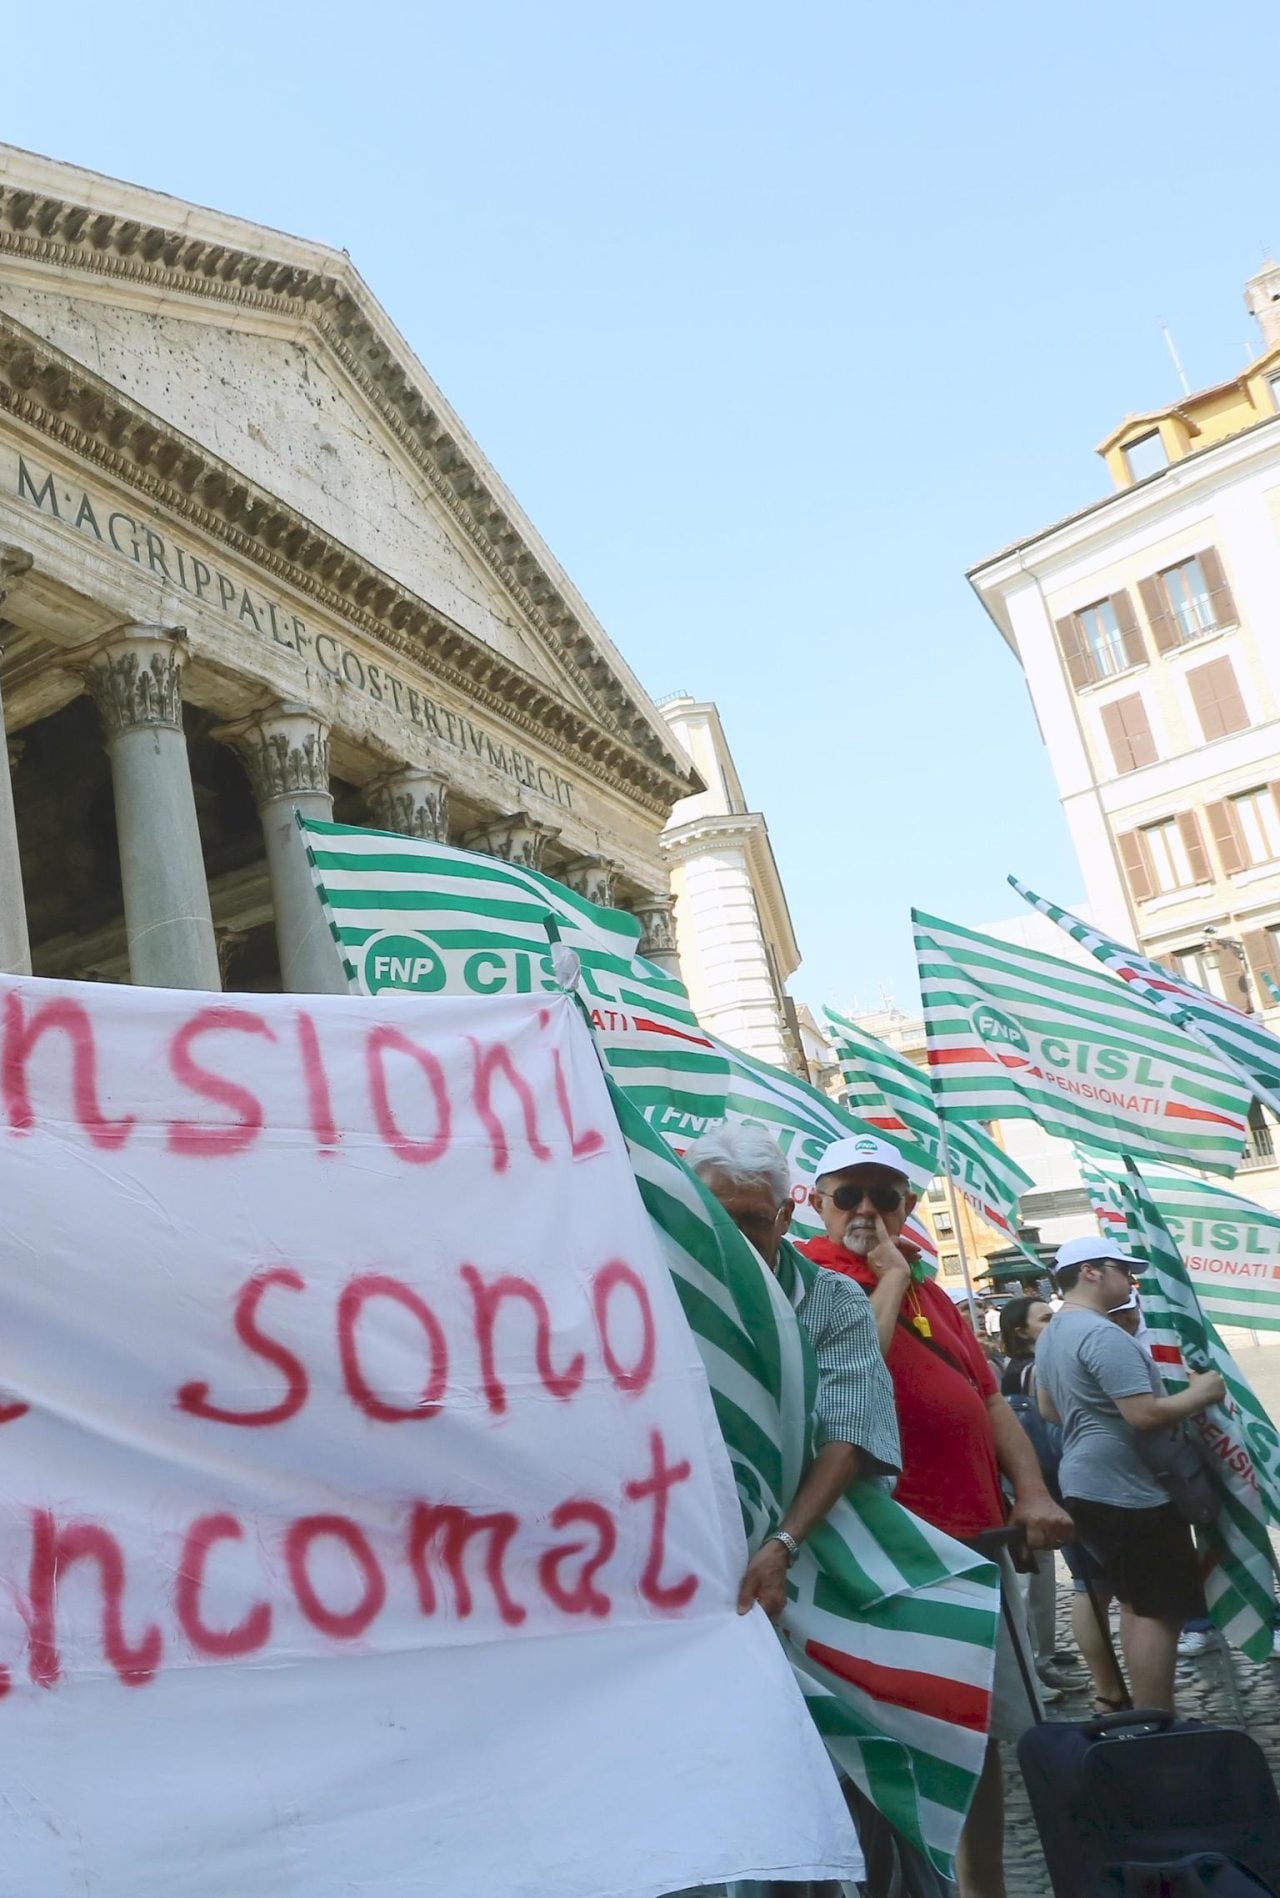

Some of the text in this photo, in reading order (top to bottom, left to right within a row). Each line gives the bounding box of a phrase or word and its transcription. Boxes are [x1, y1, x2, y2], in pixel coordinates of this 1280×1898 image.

[75, 492, 262, 632] AGRIPPA
[374, 956, 435, 984] FNP
[978, 1015, 1165, 1089] FNP CISL
[1044, 1071, 1160, 1115] PENSIONATI
[1163, 1217, 1270, 1255] CISL
[1184, 1256, 1268, 1278] SIONATI
[179, 1263, 654, 1427] sono
